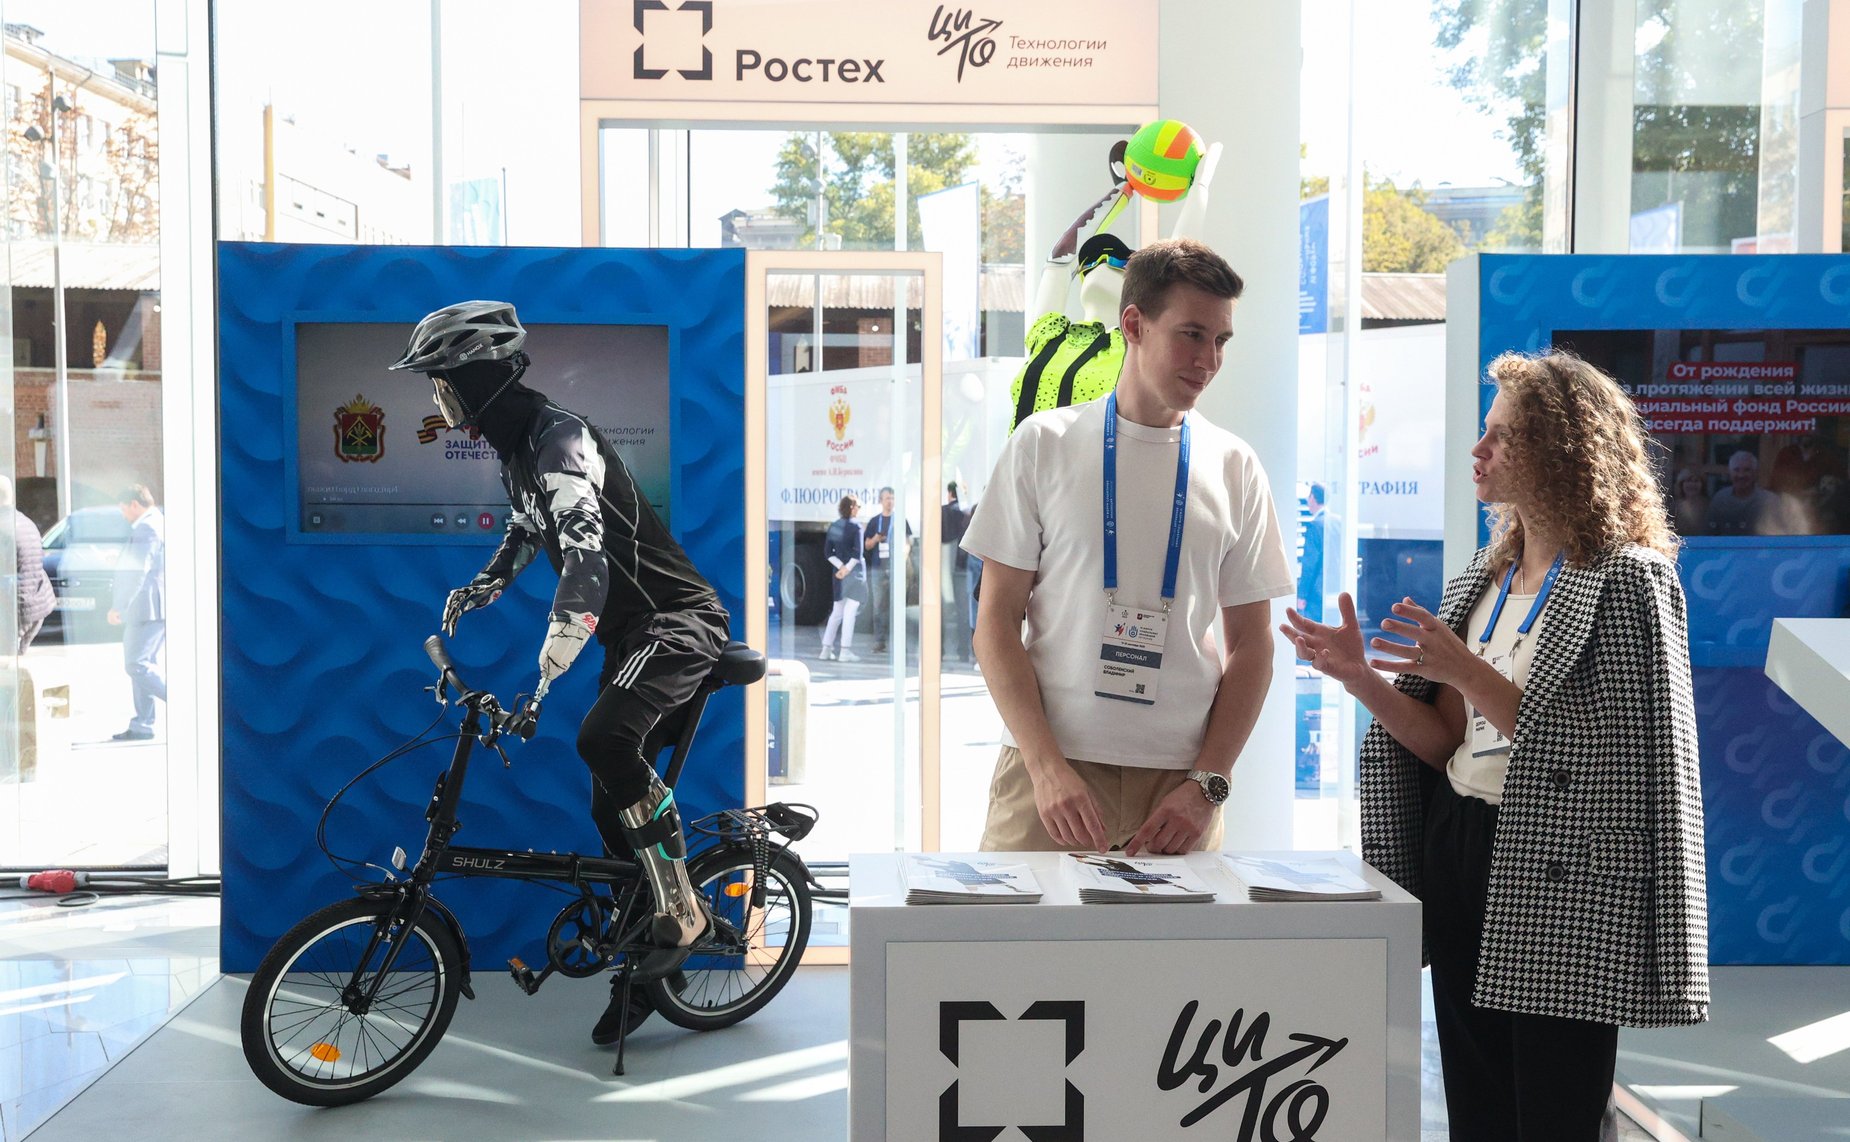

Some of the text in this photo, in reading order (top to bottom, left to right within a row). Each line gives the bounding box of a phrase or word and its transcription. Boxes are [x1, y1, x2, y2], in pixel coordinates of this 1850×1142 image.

[1009, 35, 1107, 50] Технологии
[736, 49, 885, 83] Ростех
[1006, 56, 1093, 69] движения
[1673, 364, 1794, 381] От рождения
[1637, 384, 1749, 397] протяжении
[1754, 383, 1796, 395] всей
[1641, 399, 1850, 416] циальный фонд России
[595, 427, 655, 435] ехнологии
[1709, 419, 1816, 434] поддержит!
[445, 440, 492, 449] ЗАЩИТ
[826, 439, 854, 452] РОССИИ
[1359, 481, 1418, 495] РАФИЯ
[1115, 651, 1147, 661] ПЕРСОНАЛ
[452, 856, 506, 870] SHULZ
